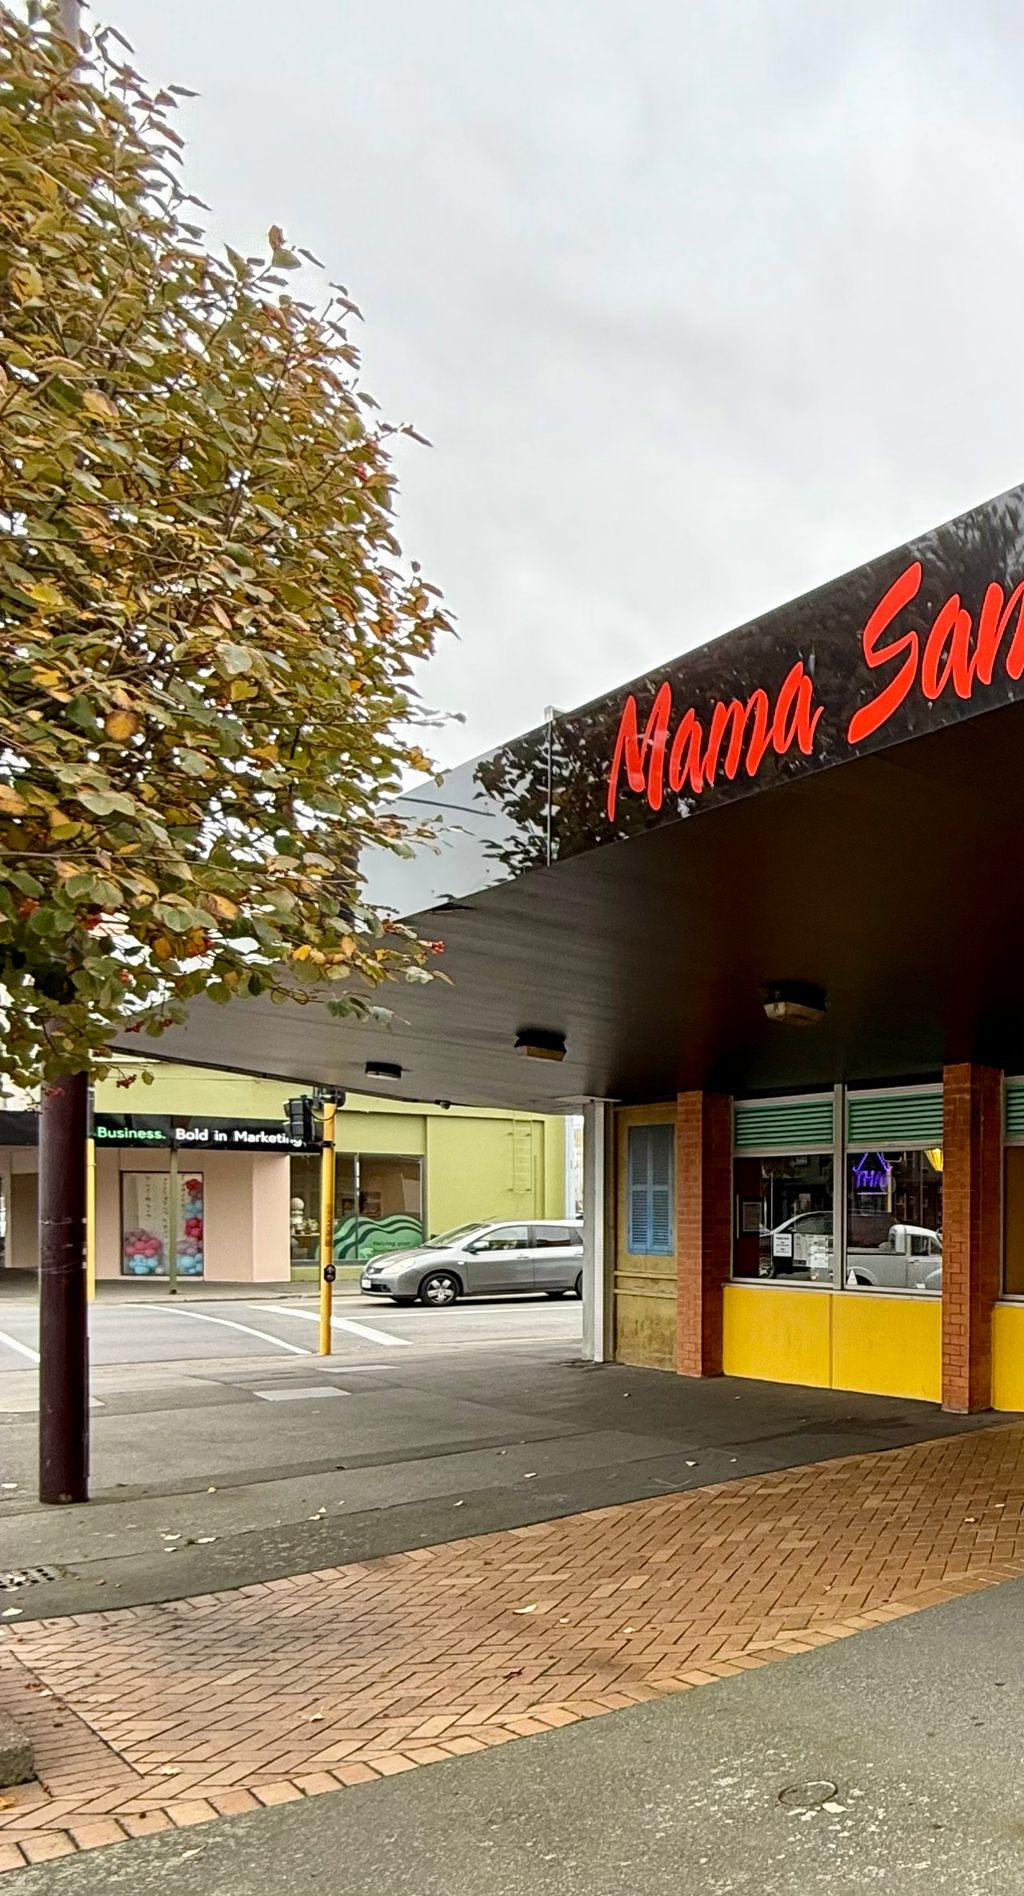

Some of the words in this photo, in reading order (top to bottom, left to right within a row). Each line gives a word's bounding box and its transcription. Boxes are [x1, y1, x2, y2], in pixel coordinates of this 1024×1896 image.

[606, 660, 825, 822] Mama
[97, 1126, 167, 1140] Business.
[175, 1128, 209, 1142] Bold
[214, 1129, 228, 1142] in
